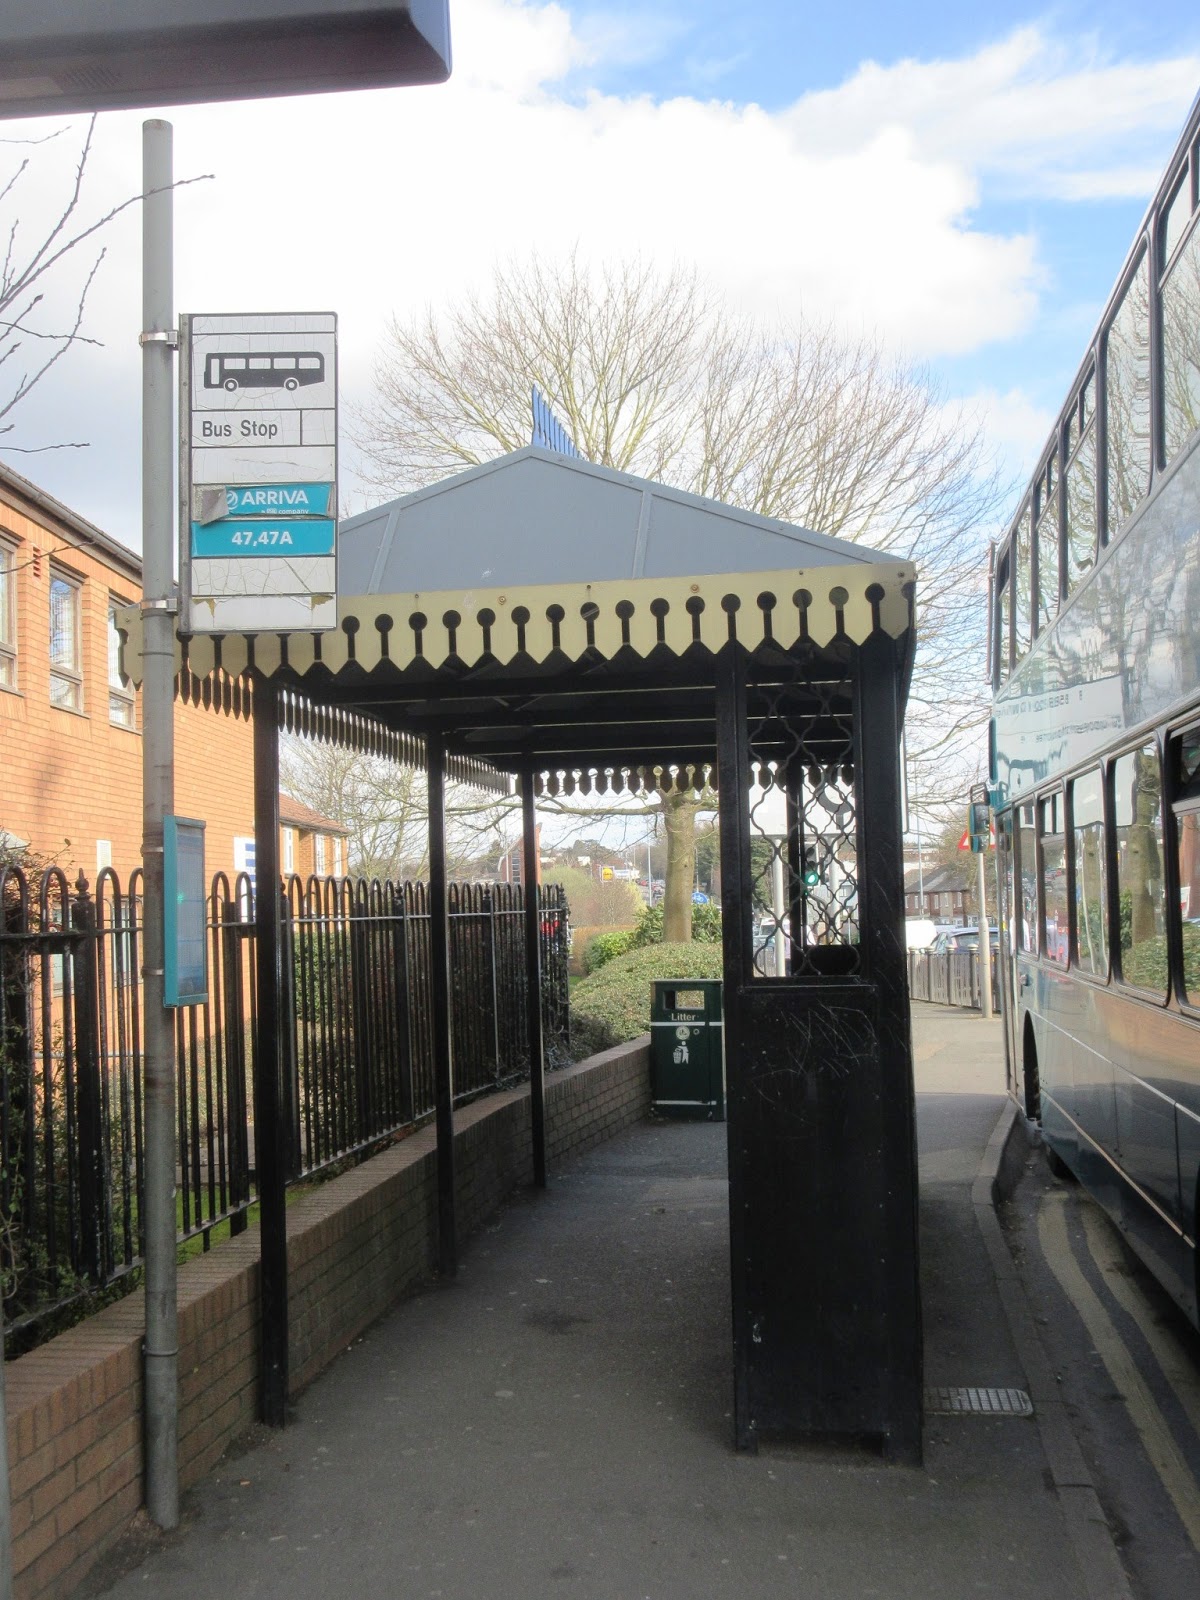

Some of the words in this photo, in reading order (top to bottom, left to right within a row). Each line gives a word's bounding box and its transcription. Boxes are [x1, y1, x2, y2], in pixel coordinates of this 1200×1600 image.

[202, 420, 232, 437] Bus
[240, 419, 278, 439] Stop
[241, 489, 309, 506] ARRIVA
[231, 531, 293, 547] 47,47A
[671, 1013, 696, 1021] Litter
